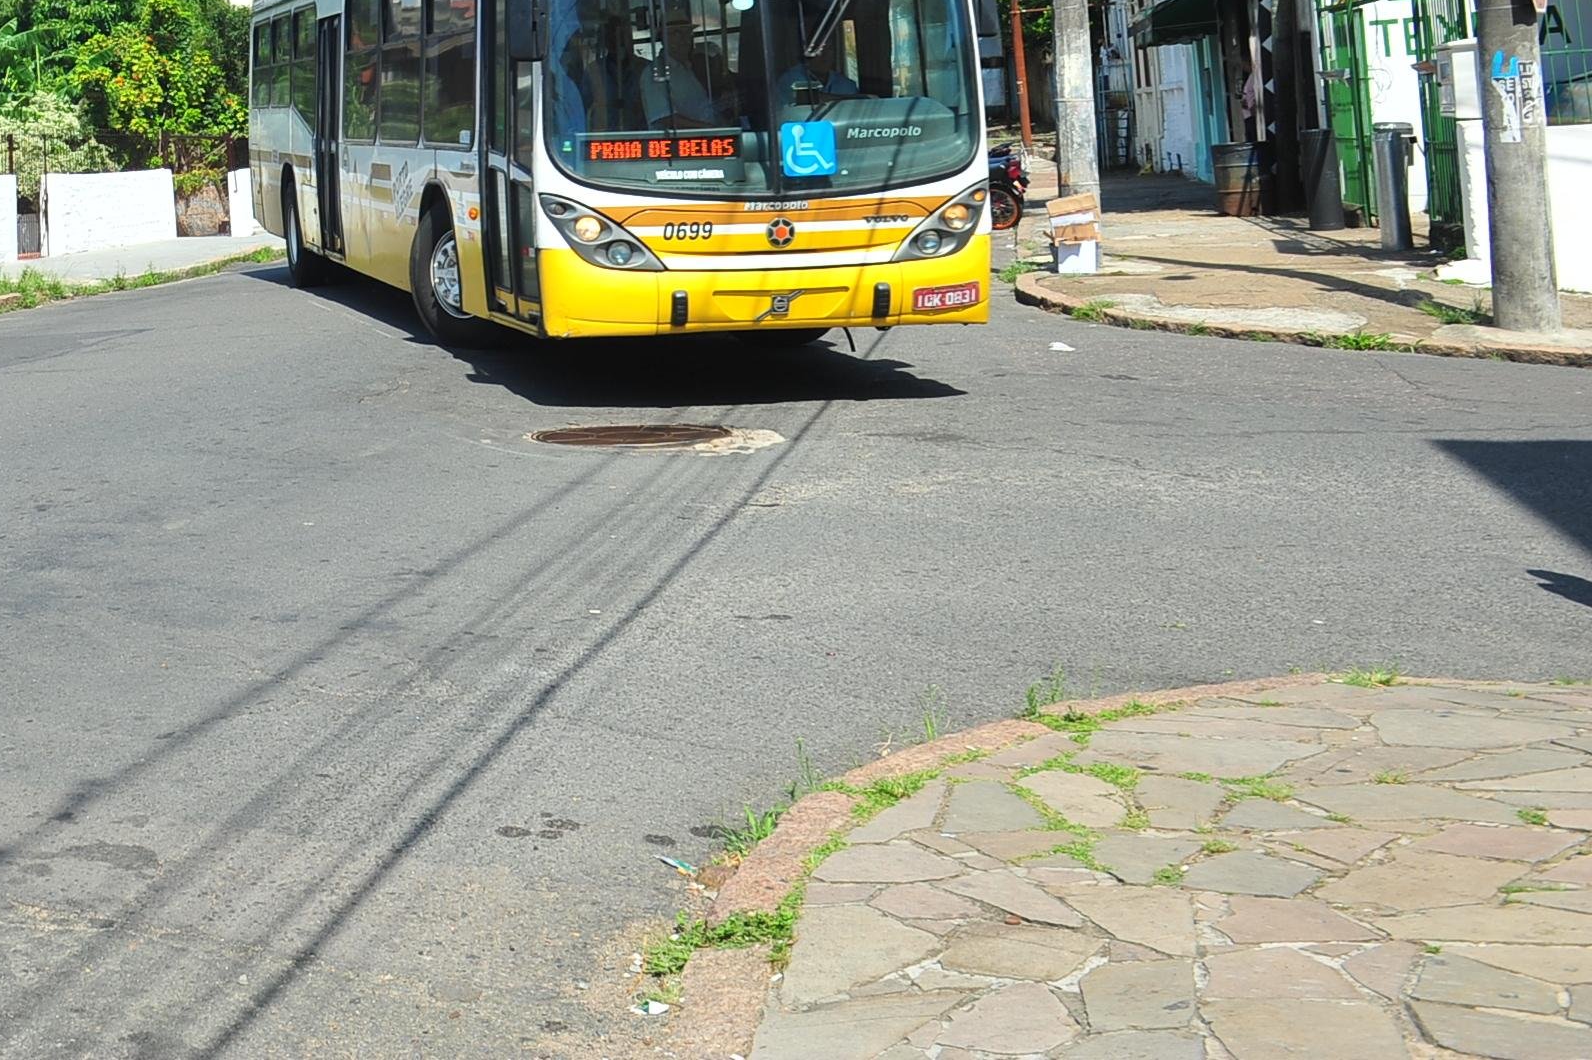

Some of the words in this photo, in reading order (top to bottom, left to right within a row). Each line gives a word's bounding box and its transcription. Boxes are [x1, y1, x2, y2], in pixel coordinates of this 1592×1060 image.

[846, 125, 922, 139] Marcopolo
[590, 142, 642, 160] PRAIA
[648, 141, 672, 158] DE
[678, 138, 734, 157] BELAS
[744, 200, 809, 211] Marcopolo
[862, 214, 909, 224] VOLVO
[663, 221, 713, 241] 0699
